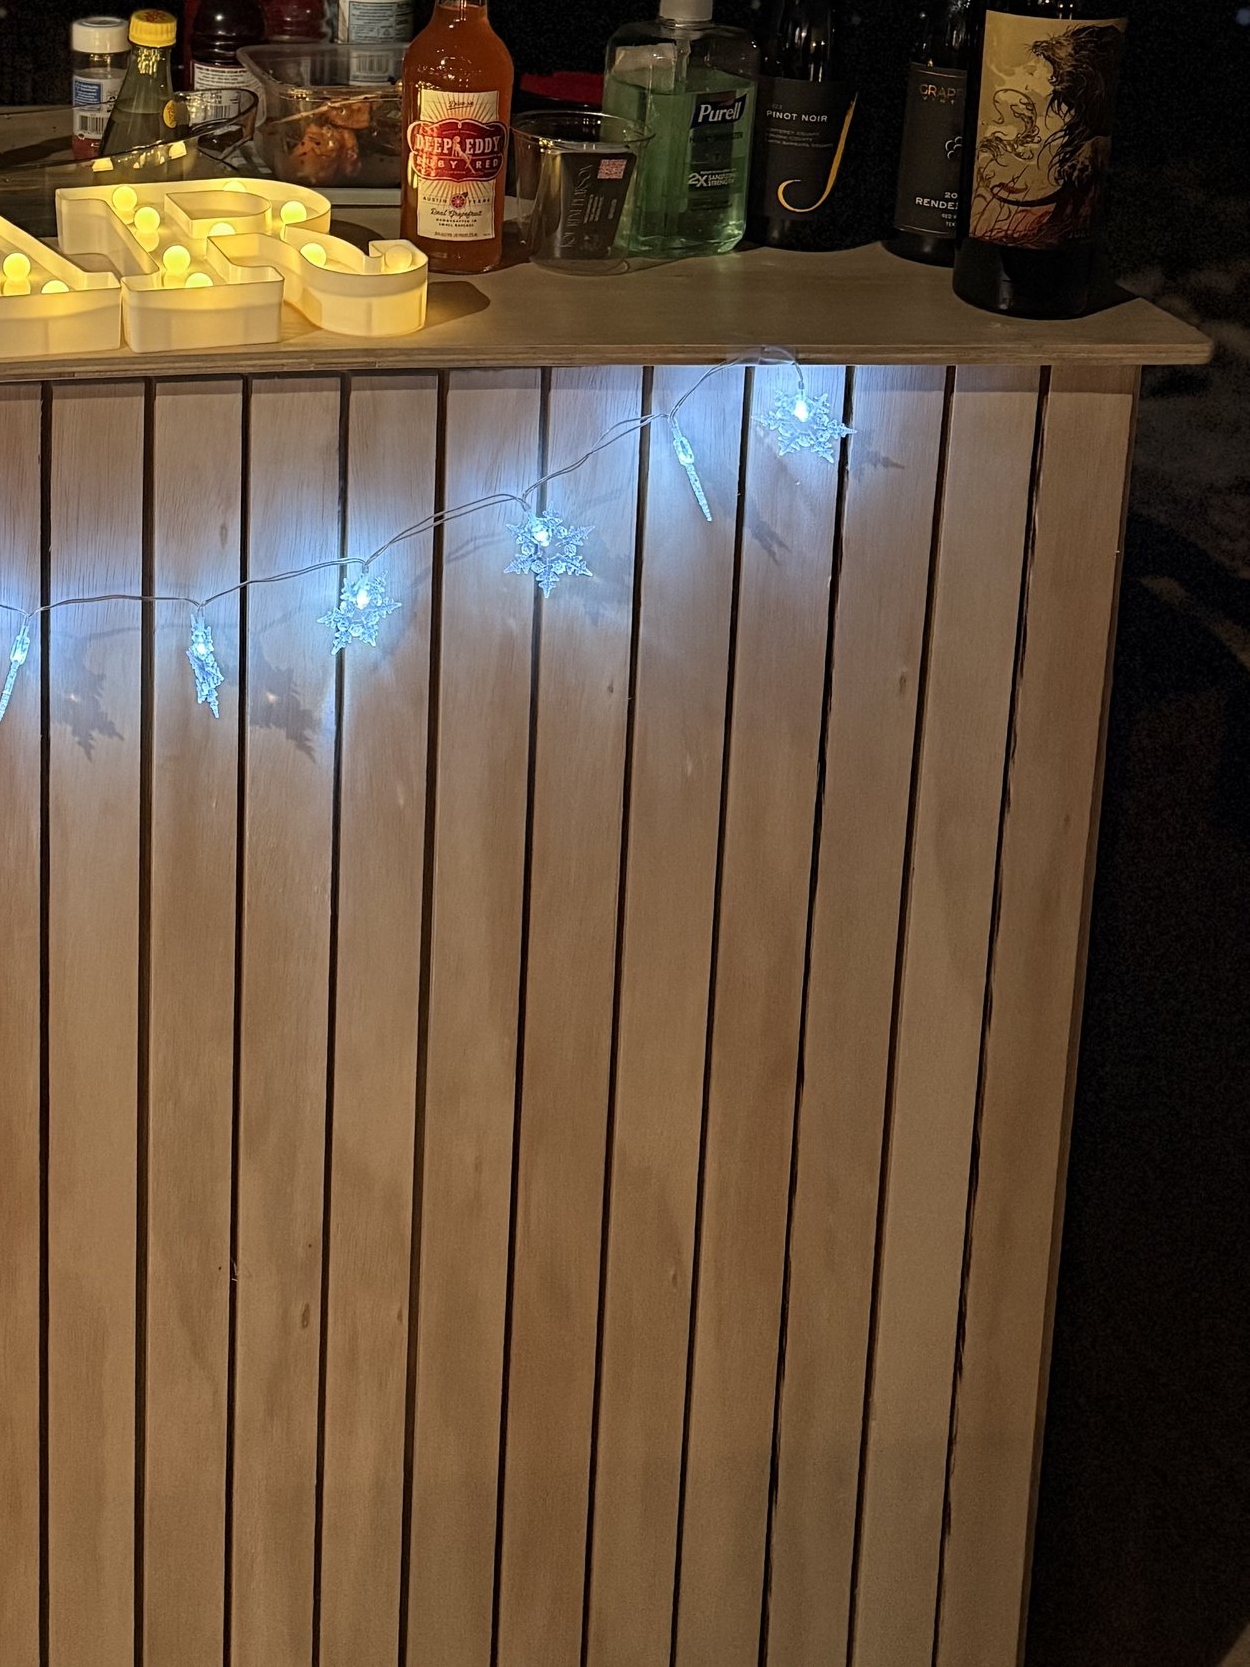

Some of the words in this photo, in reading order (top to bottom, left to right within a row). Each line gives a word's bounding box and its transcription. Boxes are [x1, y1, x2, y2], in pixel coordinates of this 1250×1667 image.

[698, 101, 742, 123] Purell
[766, 110, 798, 120] PINOT
[802, 115, 828, 123] NOIR
[416, 134, 453, 154] DEEP
[465, 136, 502, 154] EDDY
[416, 156, 458, 168] RUBY
[476, 158, 498, 168] RED
[688, 173, 708, 187] 2X
